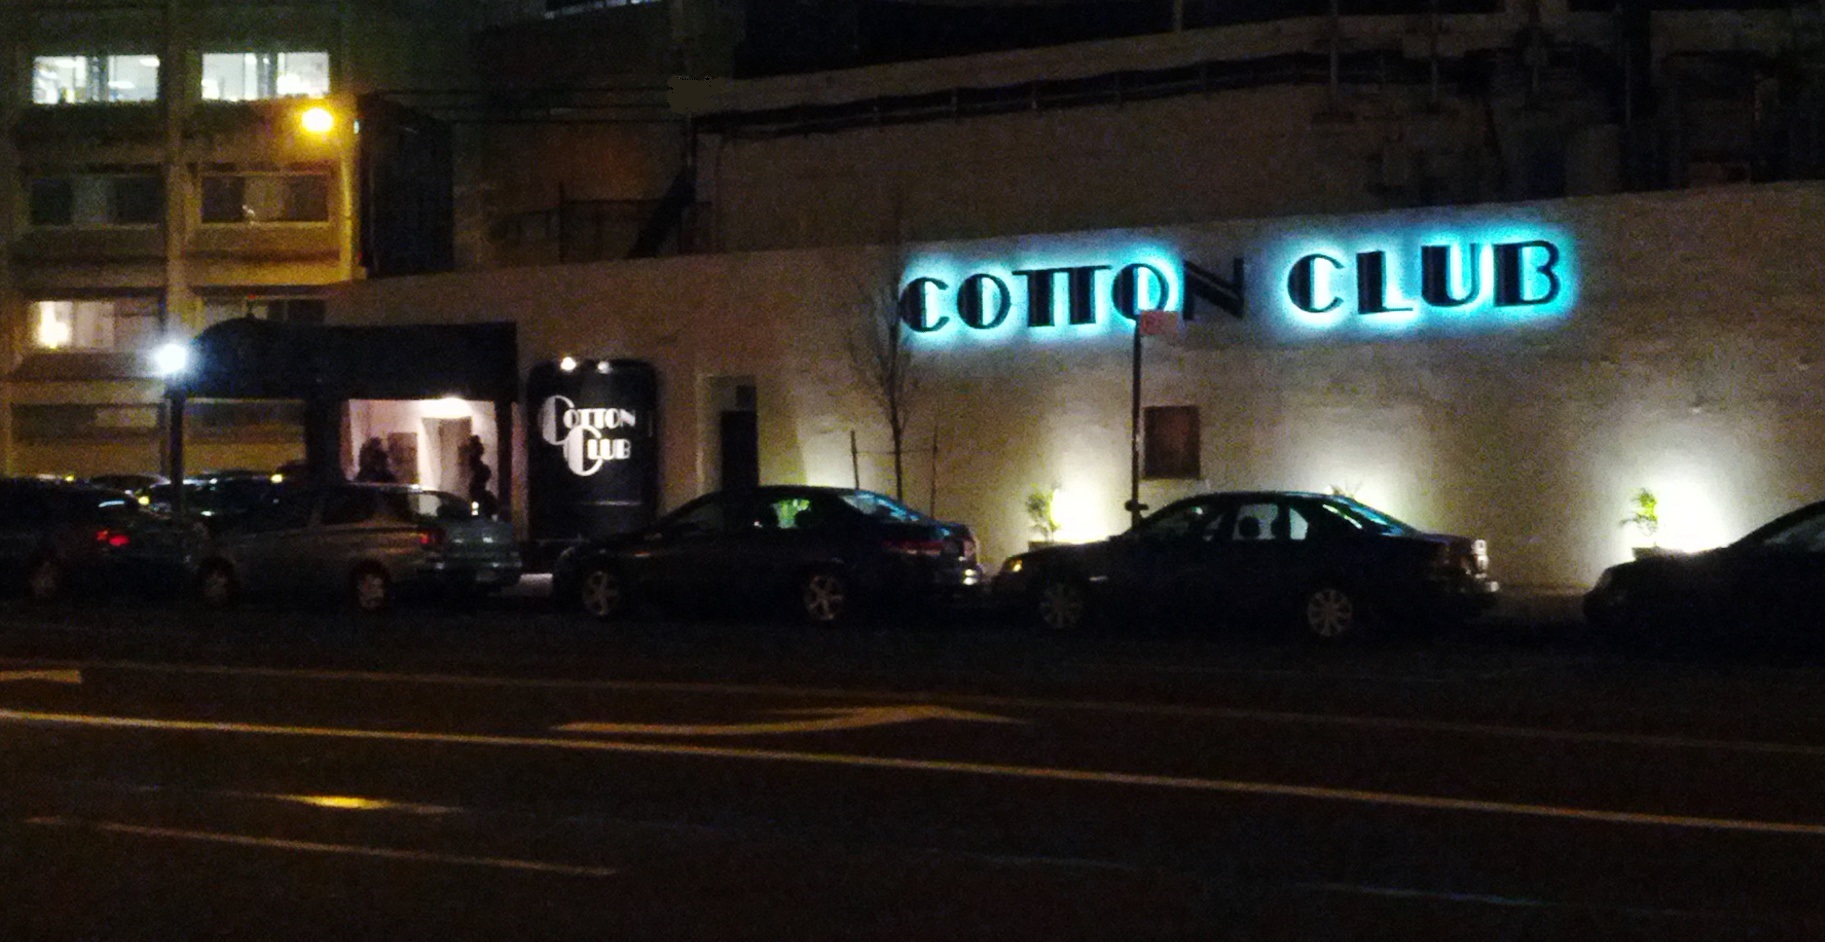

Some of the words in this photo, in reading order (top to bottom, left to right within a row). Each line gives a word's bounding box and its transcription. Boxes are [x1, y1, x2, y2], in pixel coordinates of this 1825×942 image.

[900, 256, 1244, 333] COTTON
[1287, 239, 1561, 315] CLUB
[541, 395, 636, 446] COTTON
[564, 424, 632, 476] CLUB
